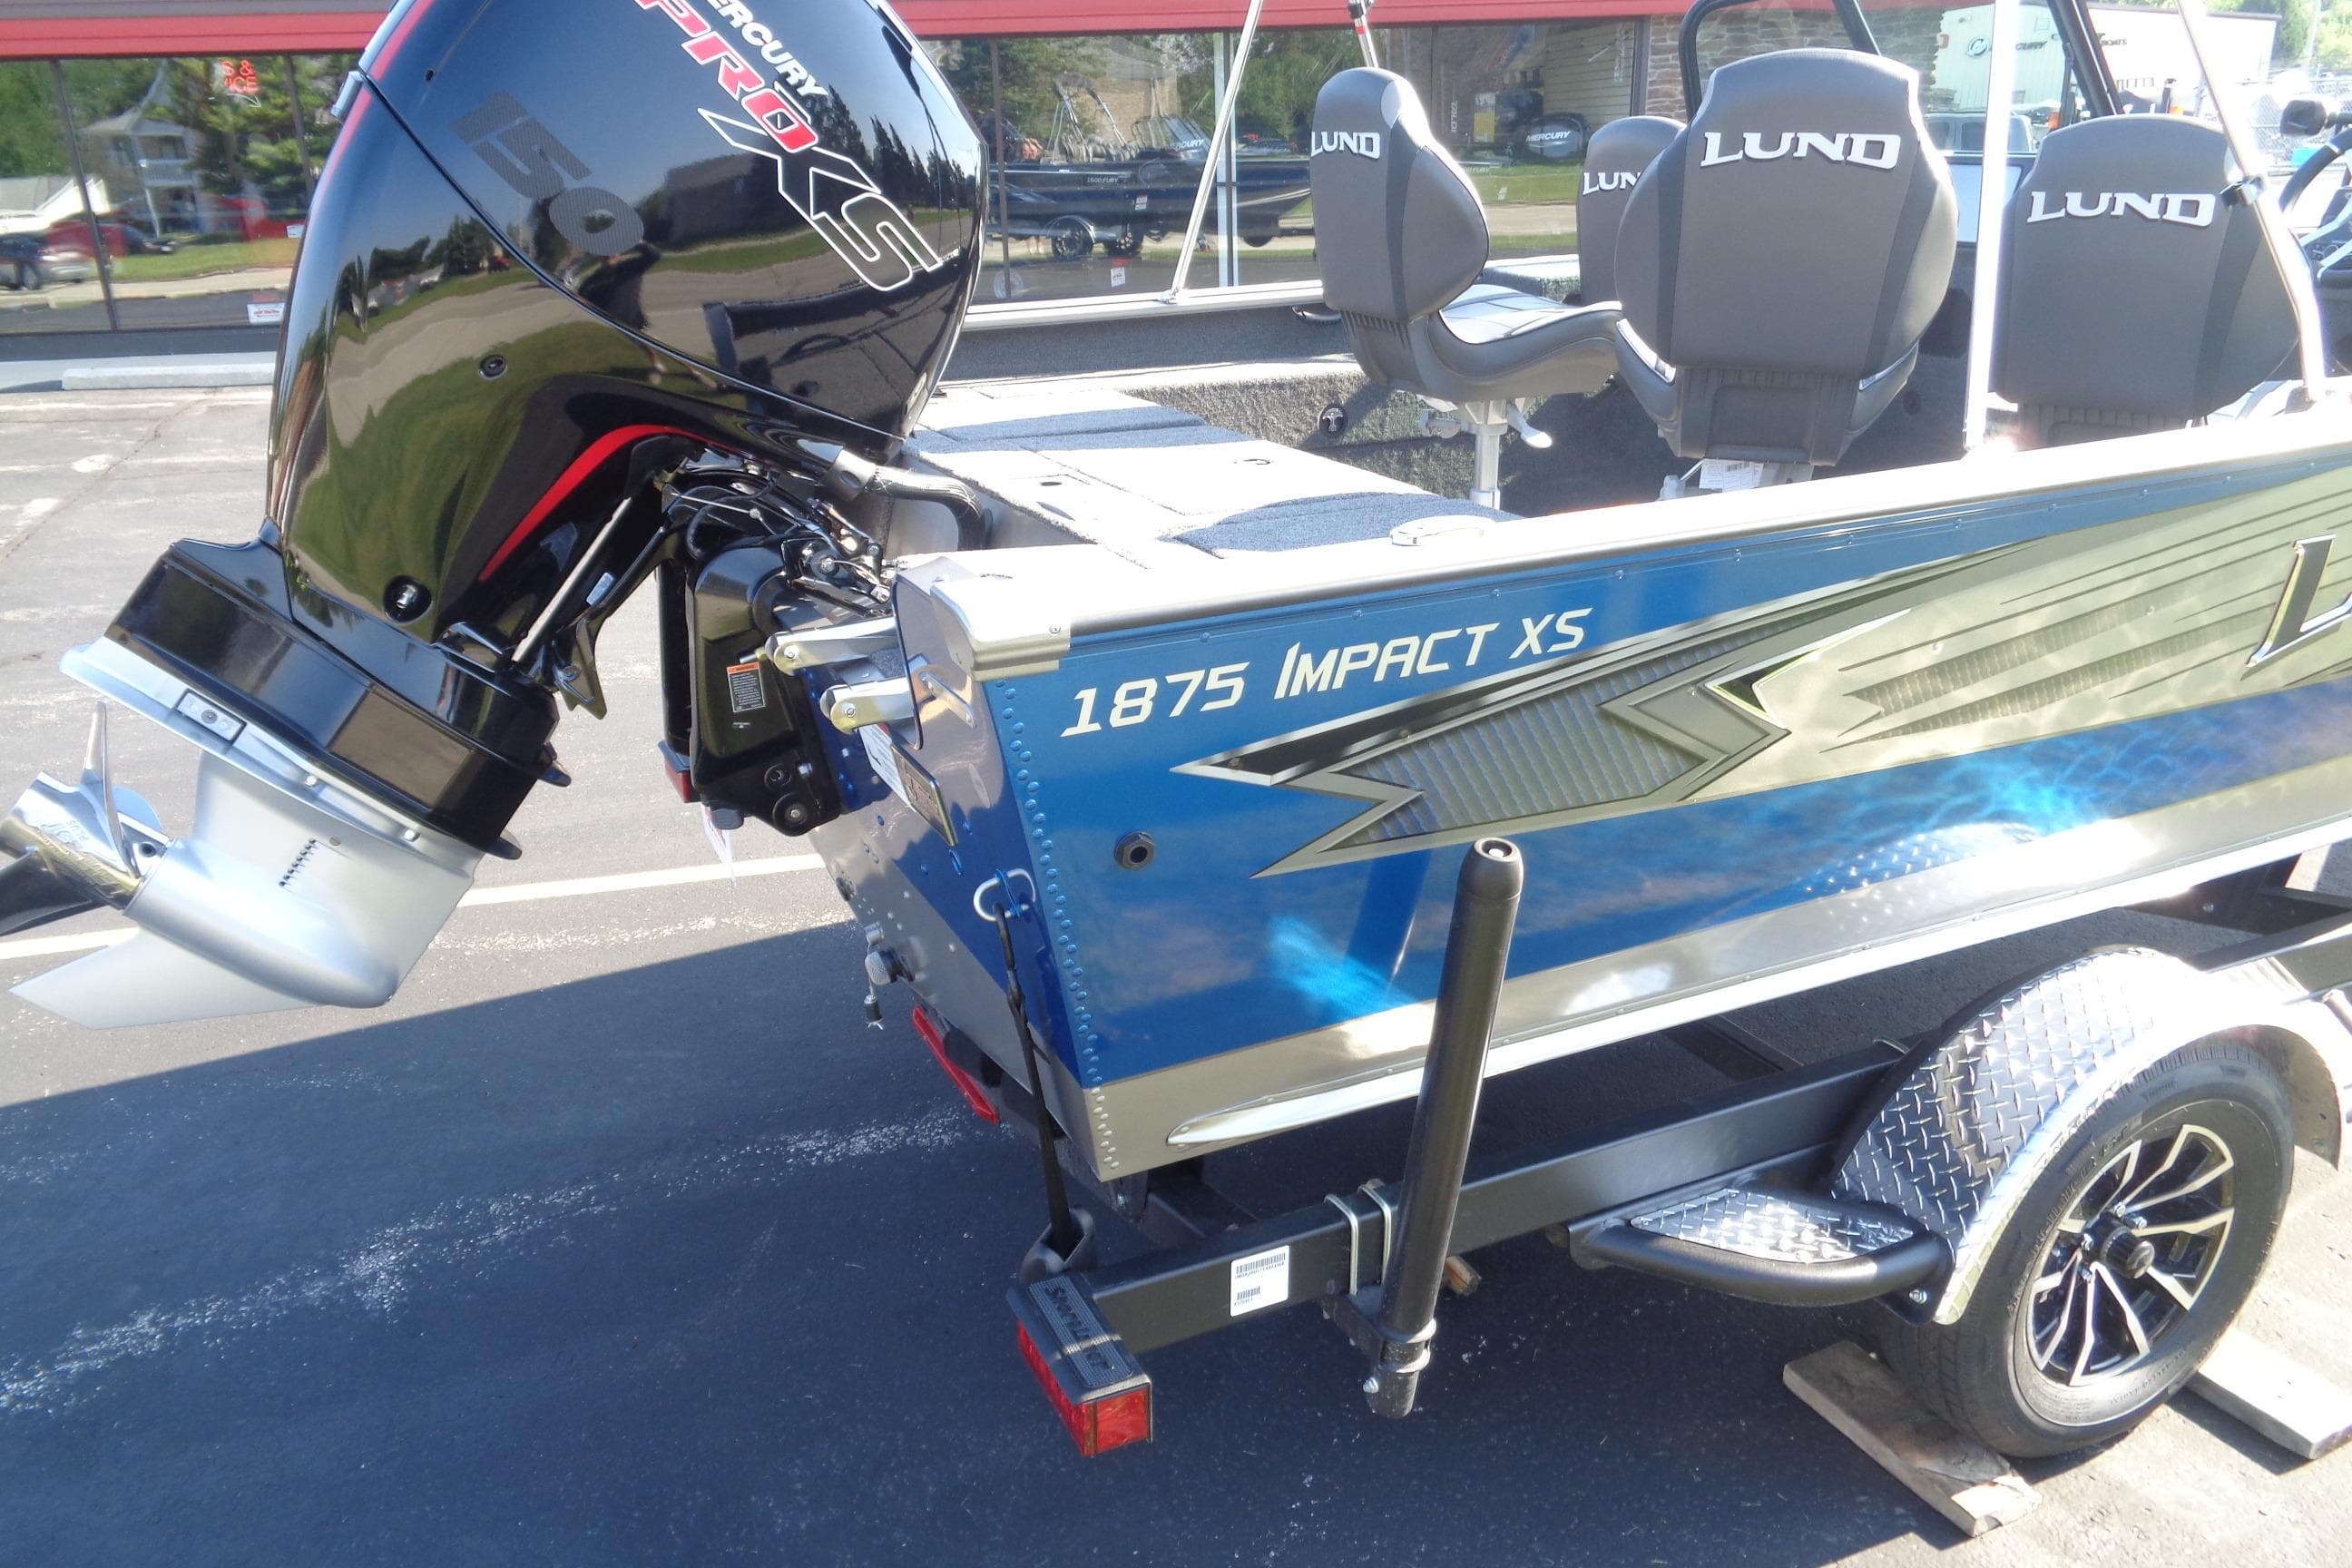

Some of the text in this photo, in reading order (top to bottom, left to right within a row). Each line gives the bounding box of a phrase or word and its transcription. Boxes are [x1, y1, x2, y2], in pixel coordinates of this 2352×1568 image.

[705, 0, 828, 96] RCURY
[632, 0, 944, 292] PRO XS
[1310, 131, 1380, 160] LUND
[1525, 131, 1571, 142] MERCURY
[1700, 132, 1902, 170] LUND
[448, 90, 646, 257] 150
[1582, 172, 1642, 195] LUN
[2026, 191, 2216, 227] LUND
[1060, 606, 1593, 739] 1875 IMPACT XS
